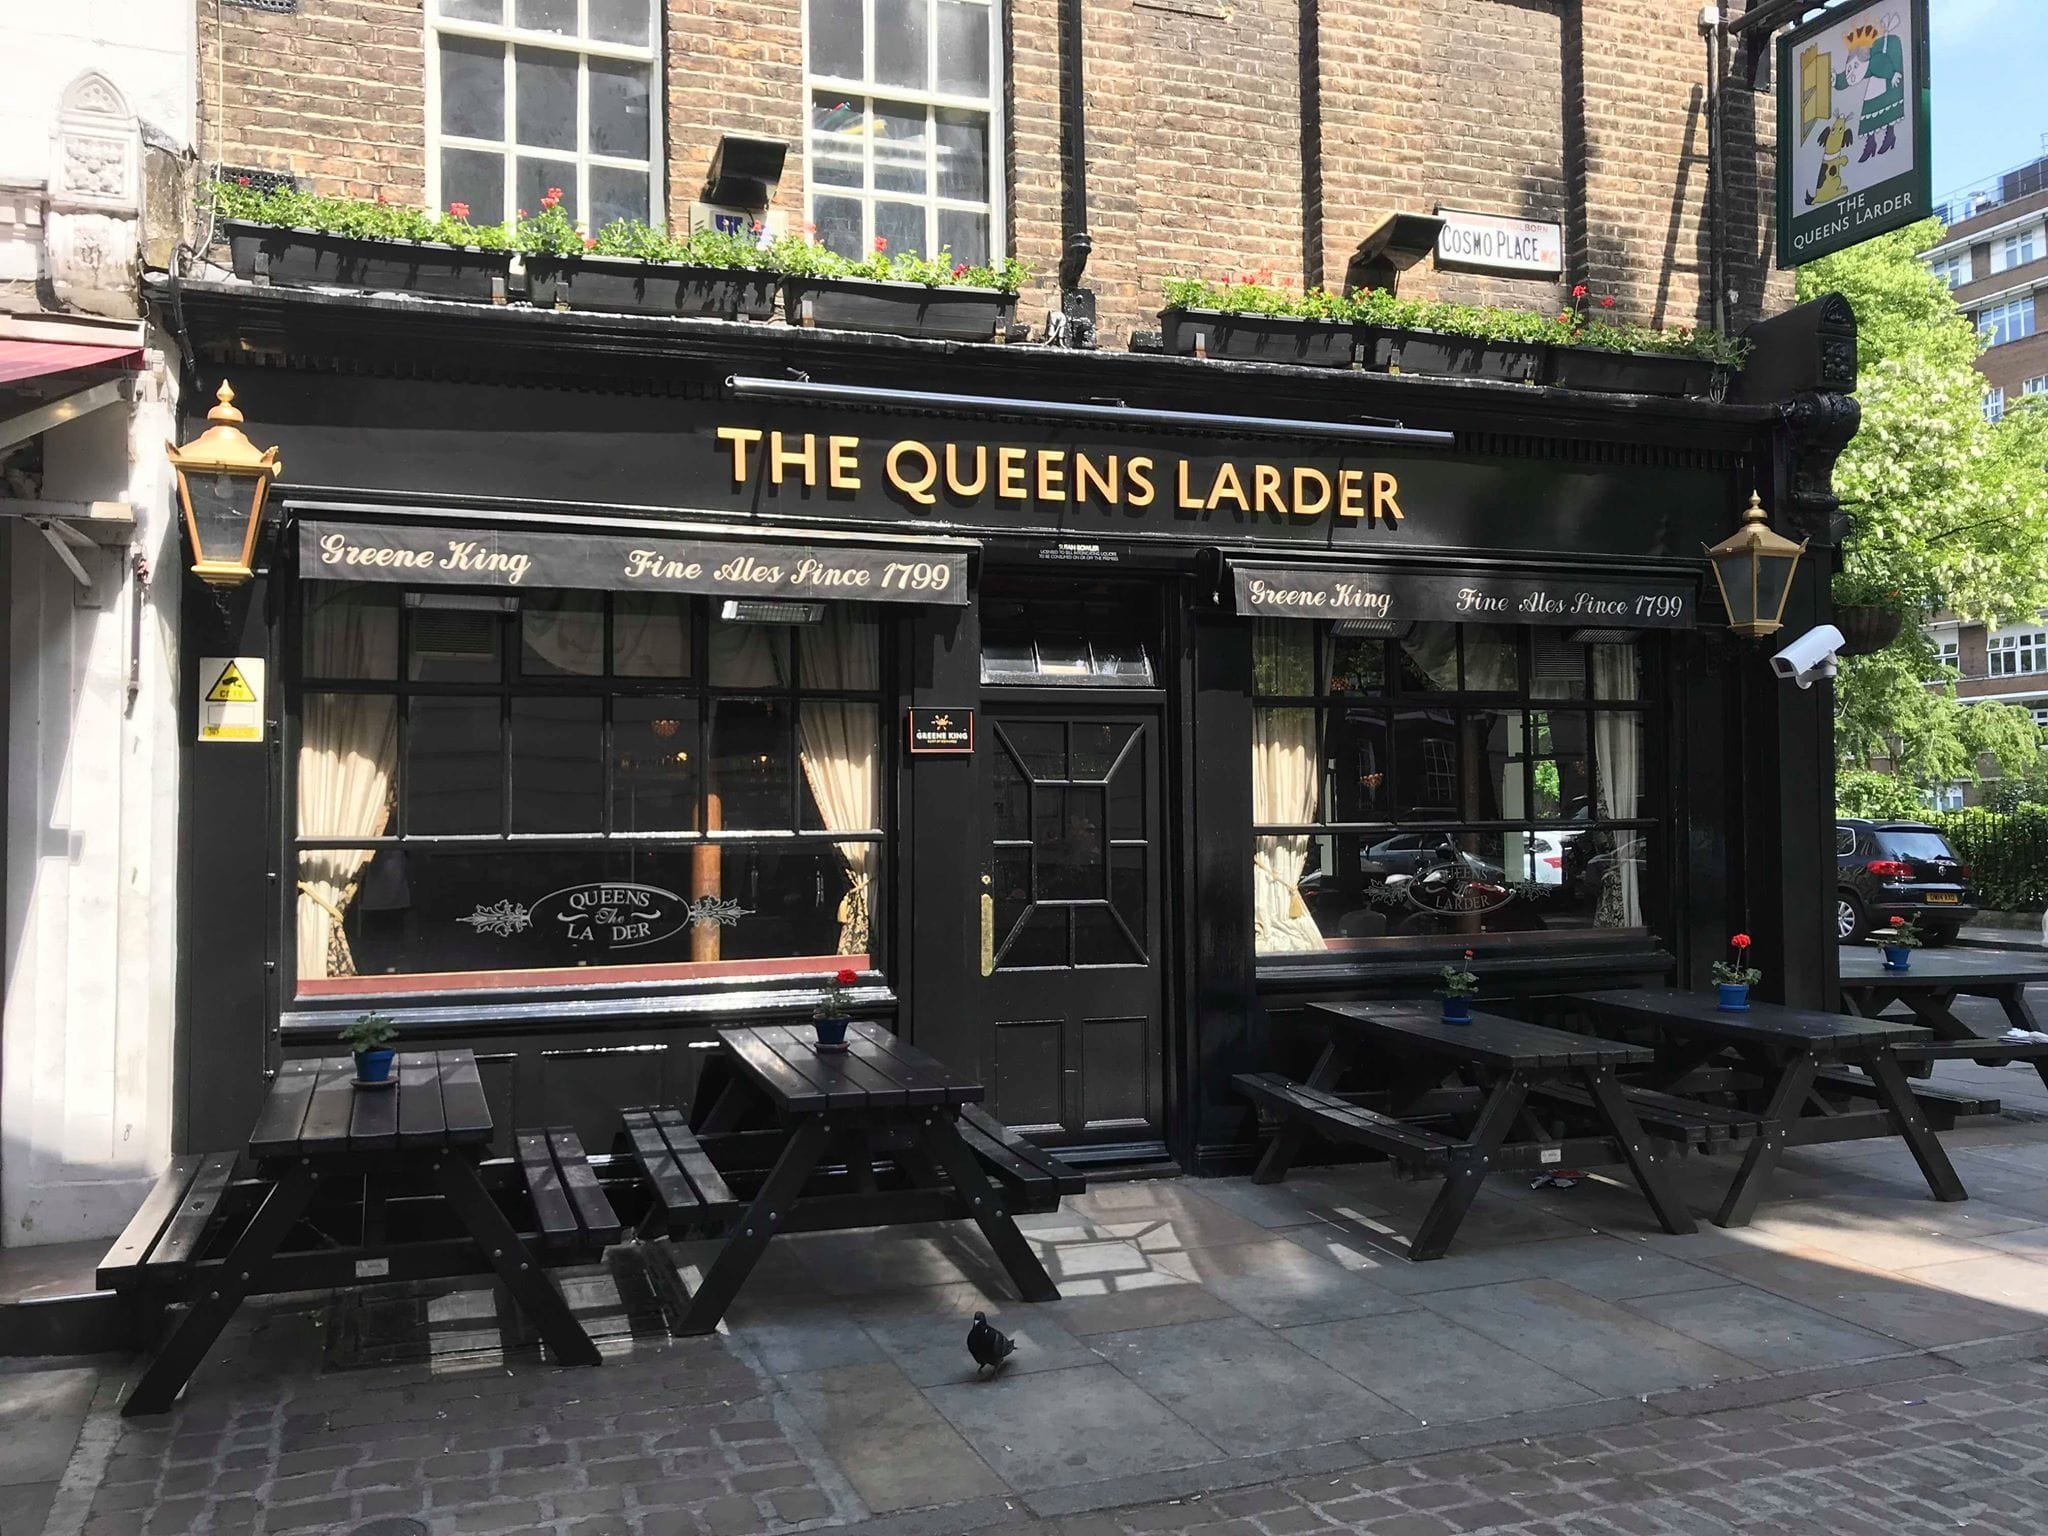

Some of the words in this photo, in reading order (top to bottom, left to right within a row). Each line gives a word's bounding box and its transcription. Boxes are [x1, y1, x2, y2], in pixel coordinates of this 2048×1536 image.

[1837, 193, 1865, 214] THE
[1793, 216, 1850, 250] QUEENS
[1856, 192, 1912, 225] LARDER
[1442, 225, 1493, 257] COSMO
[1497, 230, 1540, 262] PLACE
[717, 427, 861, 488] THE
[886, 440, 1156, 506] QUEENS
[1177, 459, 1404, 519] LARDER
[320, 534, 434, 569] Greene
[439, 541, 531, 584] King
[624, 549, 702, 580] Fine
[714, 557, 784, 583] Ales
[790, 559, 870, 587] Since
[881, 562, 950, 590] 1799
[1249, 580, 1327, 606] Greene
[1330, 583, 1393, 617] King
[1456, 588, 1510, 612] Fine
[1518, 591, 1567, 613] Ales
[1570, 592, 1628, 615] Since
[1635, 594, 1683, 617] 1799
[916, 731, 947, 740] GREENE
[948, 732, 968, 740] KING
[569, 889, 650, 910] QUEENS
[1435, 894, 1490, 911] LARDER
[567, 922, 651, 941] LADER
